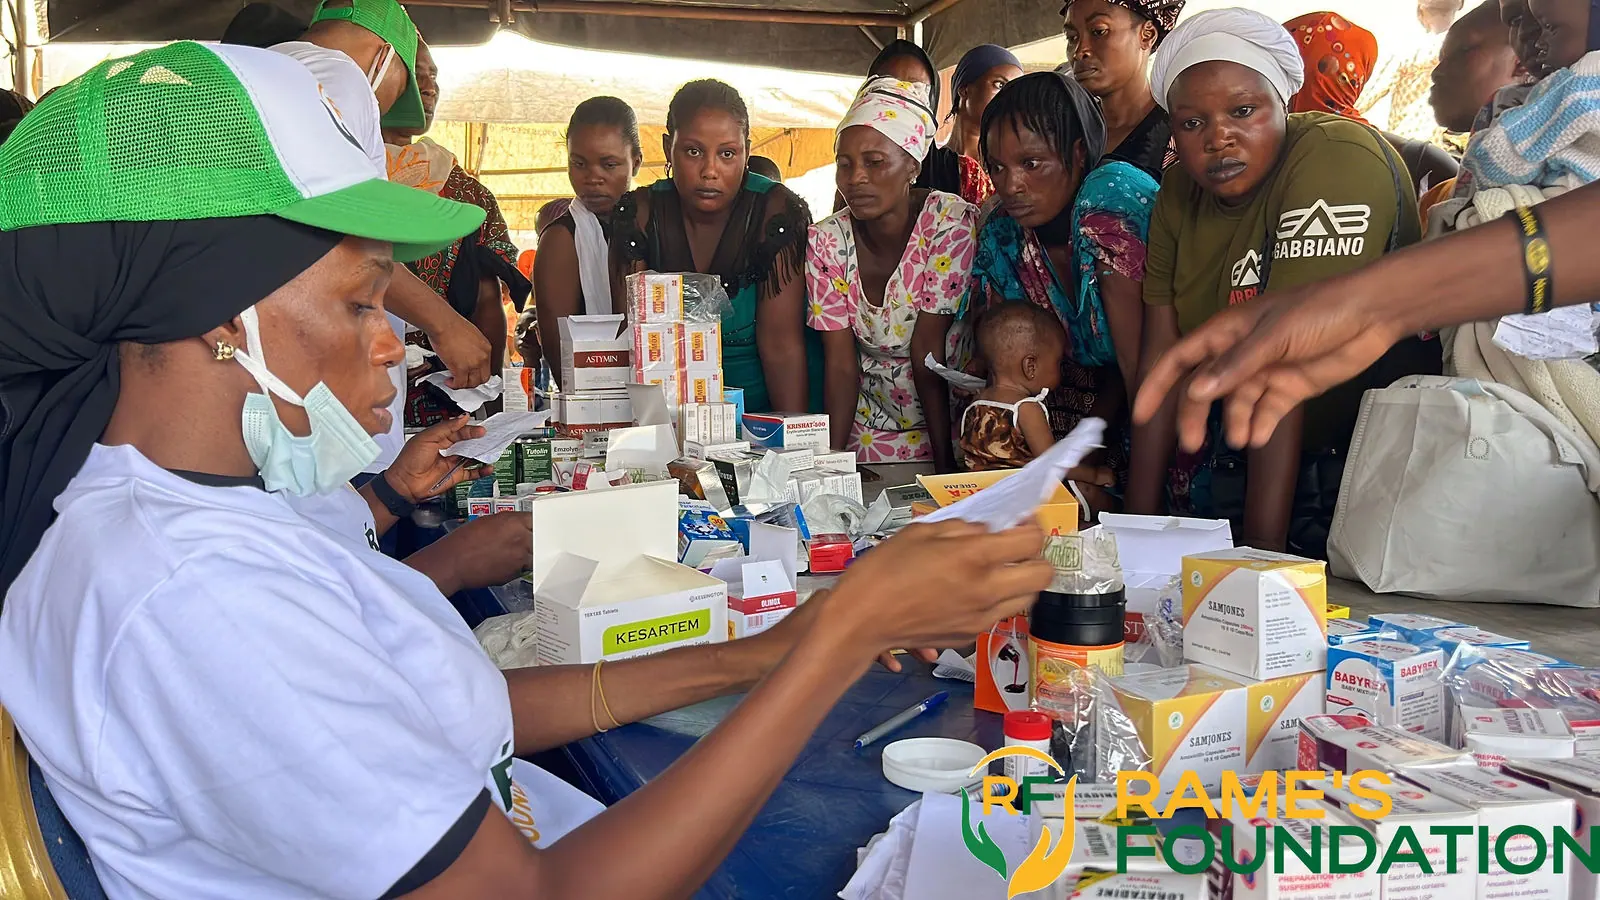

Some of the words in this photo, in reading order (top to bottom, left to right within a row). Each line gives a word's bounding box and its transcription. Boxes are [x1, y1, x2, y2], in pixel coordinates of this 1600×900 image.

[1274, 236, 1364, 259] GABBIANO
[586, 355, 618, 363] ASTYMIN
[1208, 600, 1245, 618] SAMJONES
[616, 618, 699, 645] KESARTEM
[1400, 659, 1438, 677] BABYREX
[1335, 671, 1388, 693] BABYREX
[1189, 731, 1232, 748] SAMJONES
